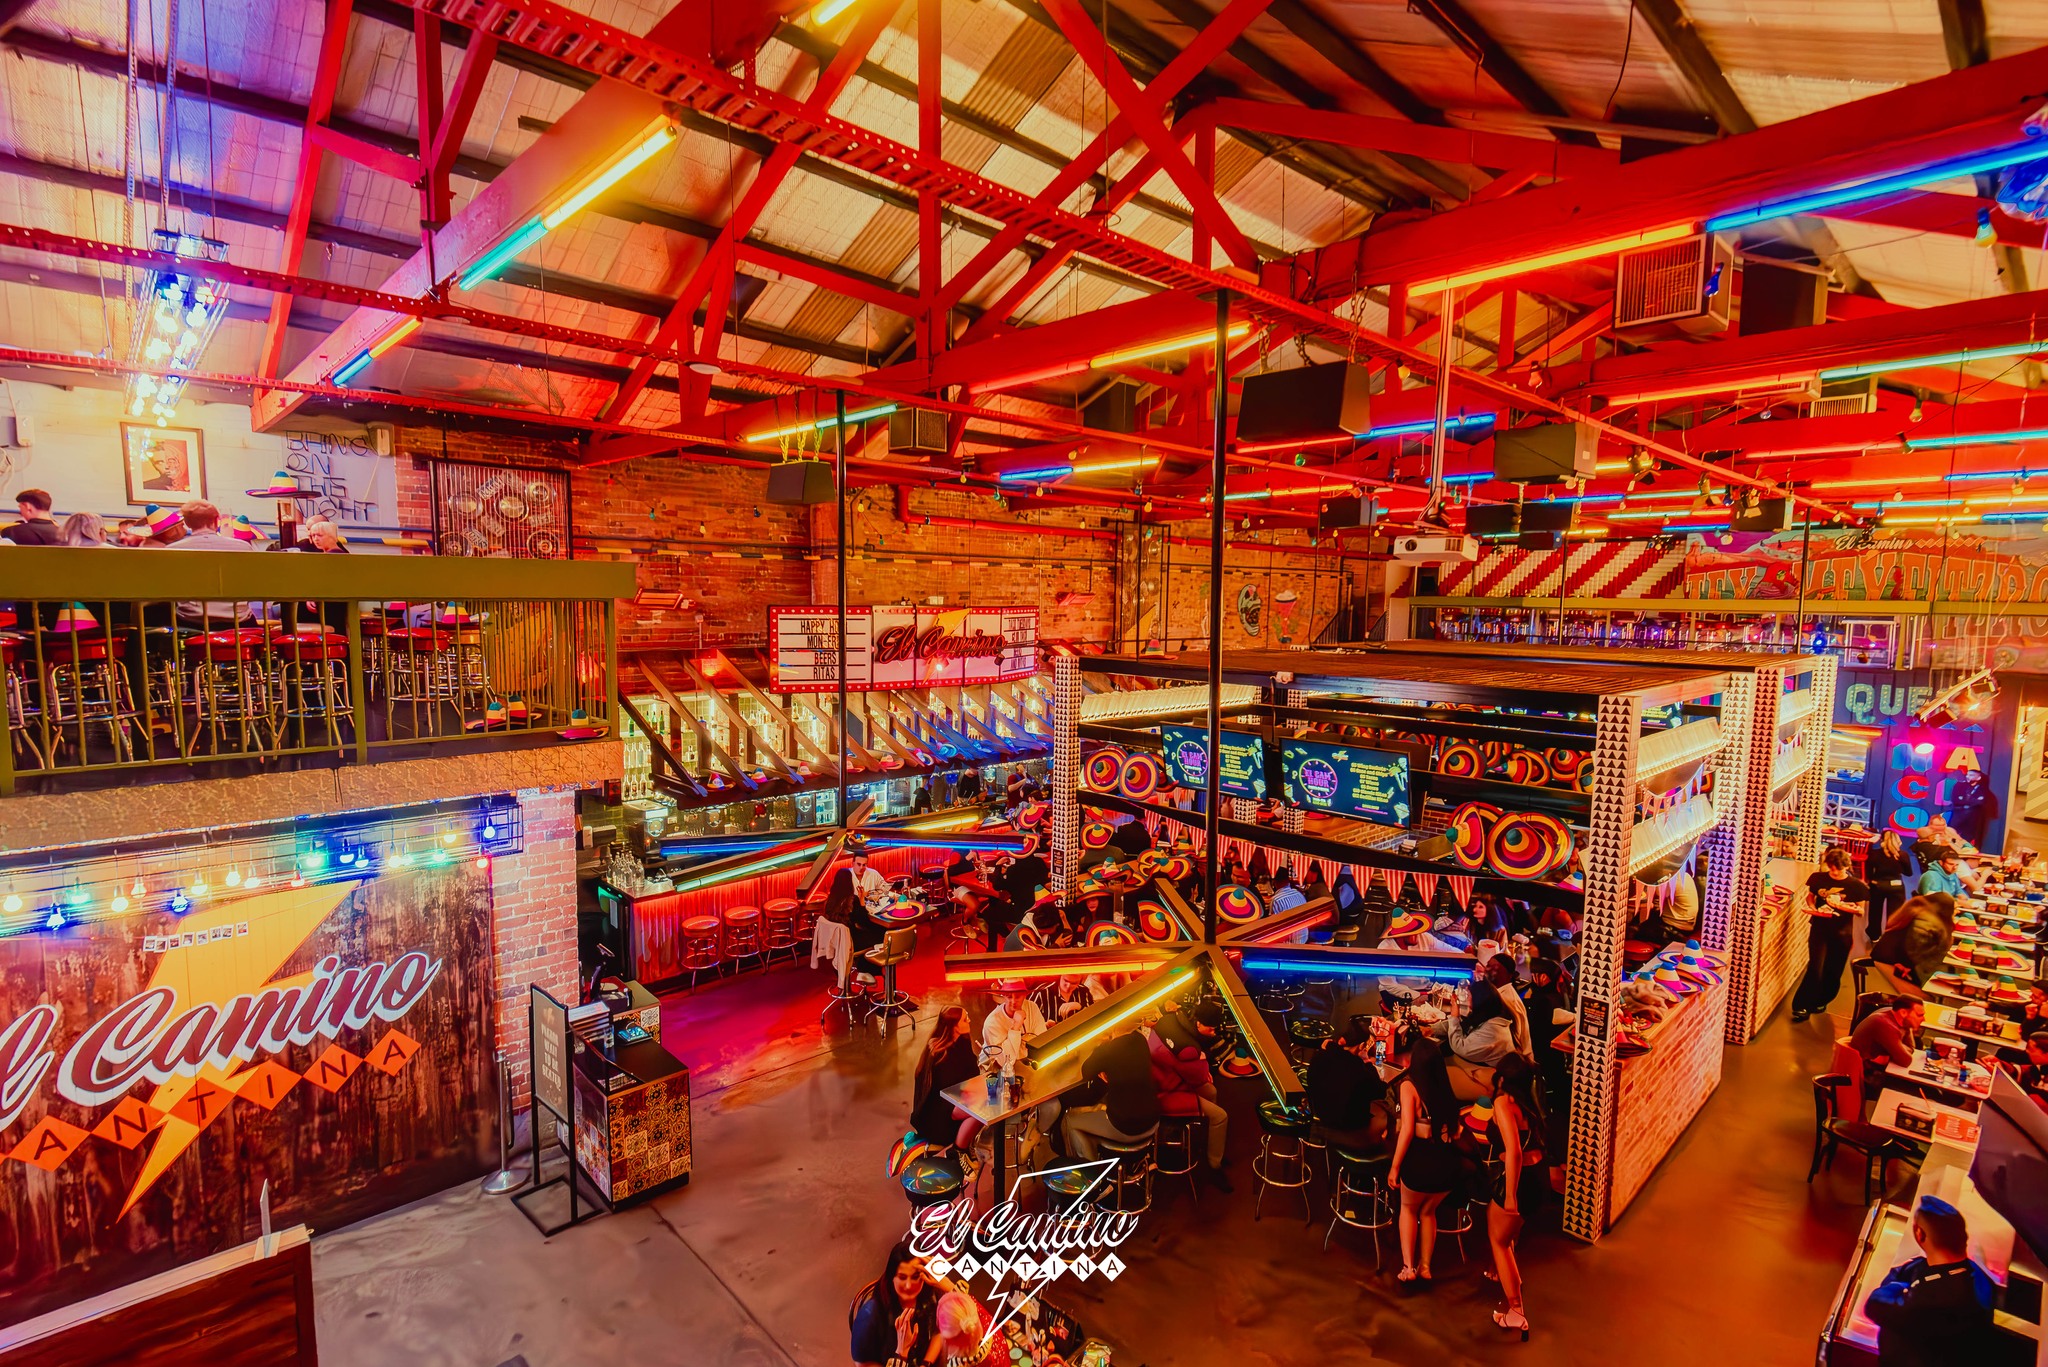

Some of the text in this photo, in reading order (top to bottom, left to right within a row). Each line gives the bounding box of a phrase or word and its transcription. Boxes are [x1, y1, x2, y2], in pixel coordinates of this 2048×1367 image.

[286, 453, 331, 475] ON
[290, 475, 347, 498] THE
[800, 620, 825, 634] HAPPY
[876, 624, 1008, 665] El Camino
[815, 652, 837, 665] BEERS
[813, 667, 836, 680] RITAS
[57, 952, 442, 1107] Camino
[32, 1039, 408, 1161] ANTINA
